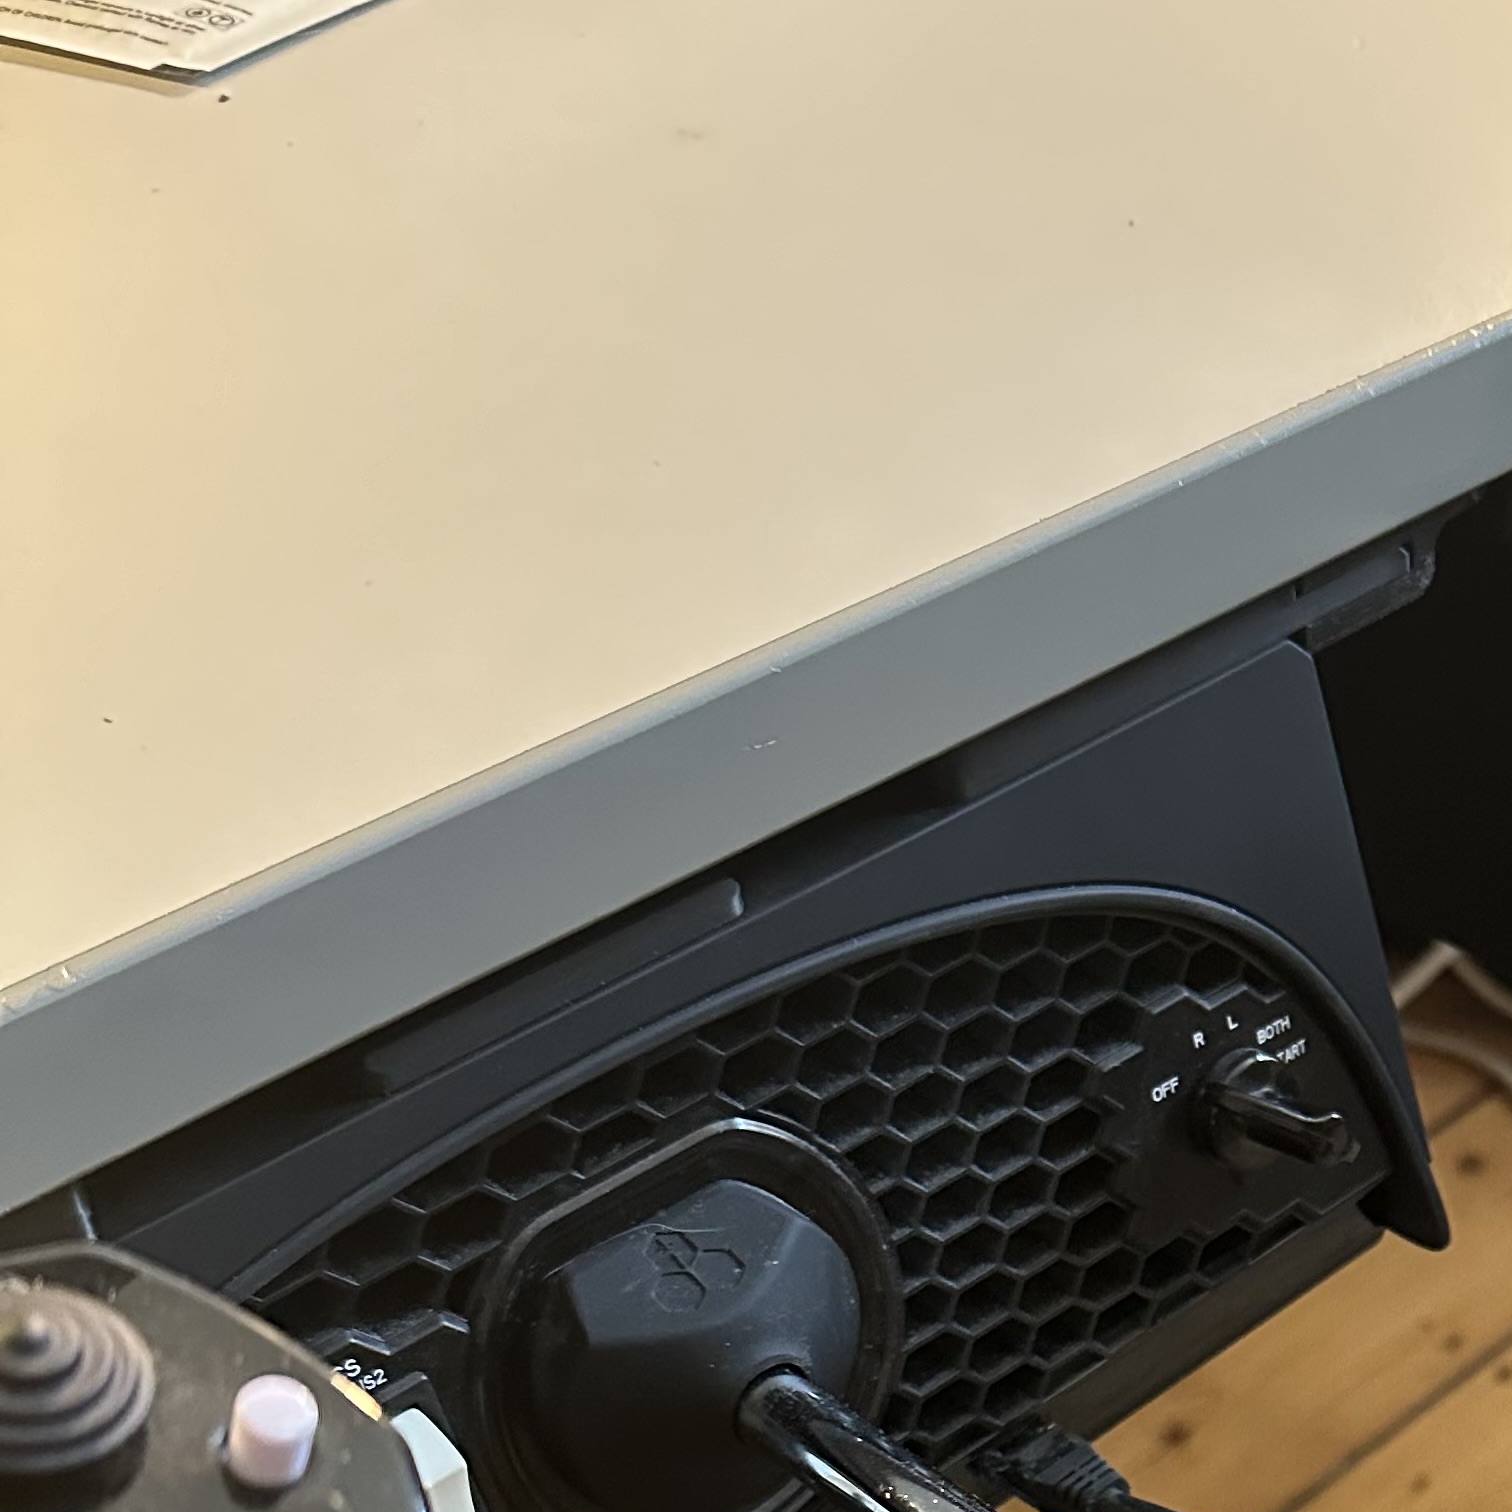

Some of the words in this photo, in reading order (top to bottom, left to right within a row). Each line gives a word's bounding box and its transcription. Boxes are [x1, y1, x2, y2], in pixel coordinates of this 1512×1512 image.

[1225, 1015, 1239, 1030] L
[1256, 1015, 1292, 1045] BOTH
[1192, 1031, 1205, 1048] R
[1277, 1038, 1307, 1064] TART
[1151, 1076, 1179, 1102] OFF
